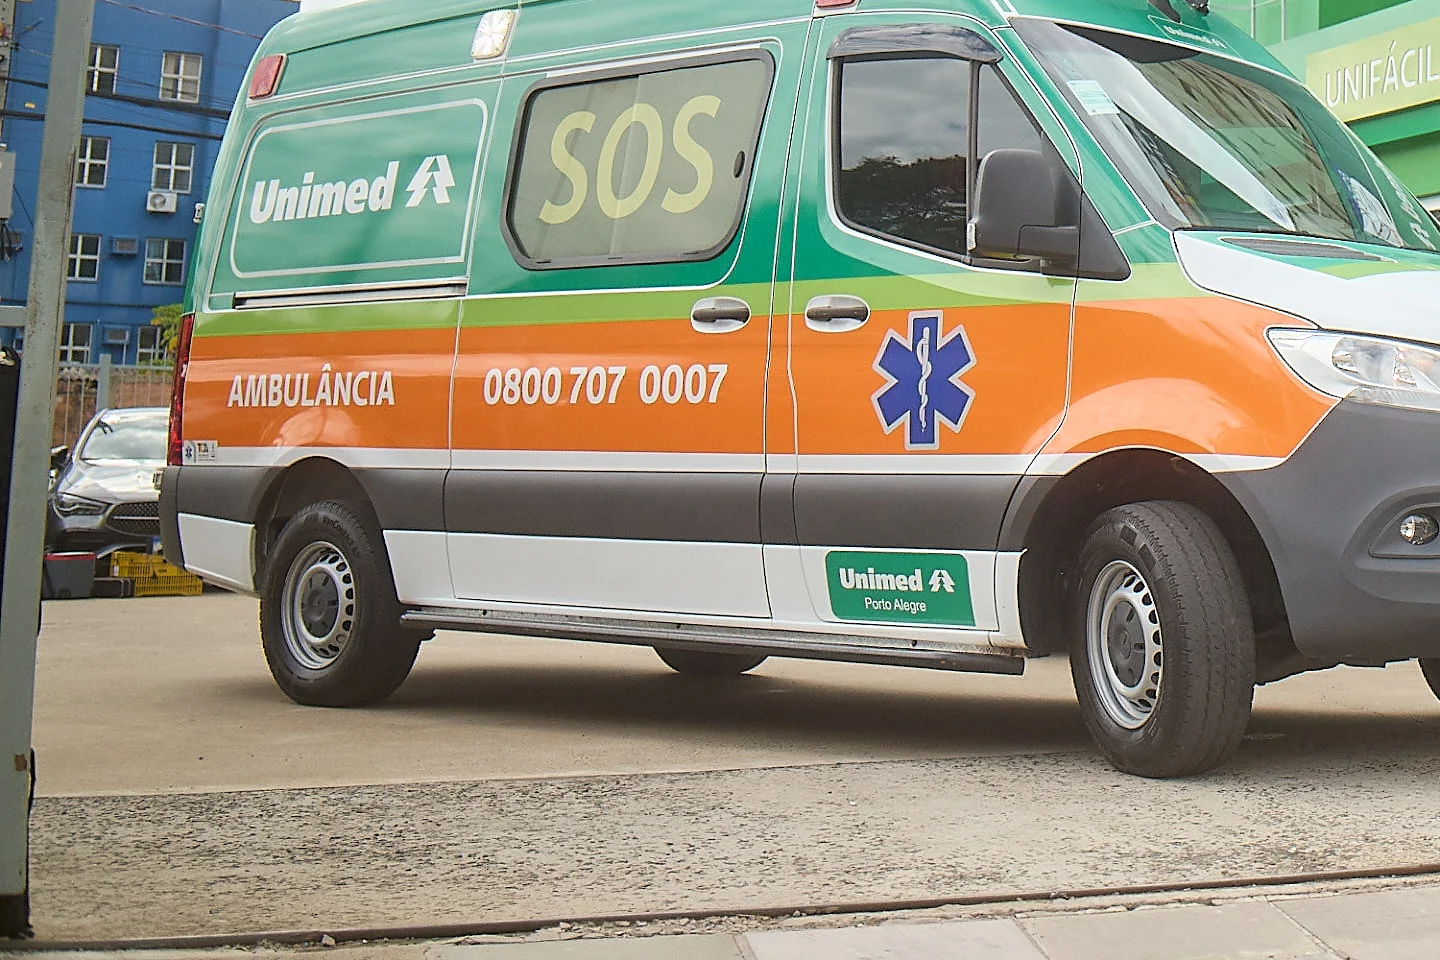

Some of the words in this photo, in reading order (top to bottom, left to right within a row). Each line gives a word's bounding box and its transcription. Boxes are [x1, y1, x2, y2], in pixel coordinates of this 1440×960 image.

[1325, 40, 1440, 107] UNIFÁCIL
[538, 95, 721, 225] SOS
[250, 160, 400, 224] Unimed
[226, 363, 395, 409] AMBULÂNCIA
[482, 366, 562, 407] 0800
[569, 366, 626, 406] 707
[639, 363, 728, 406] 0007
[839, 567, 923, 592] Unimed
[864, 597, 892, 611] Porto
[893, 598, 927, 615] Alegre
